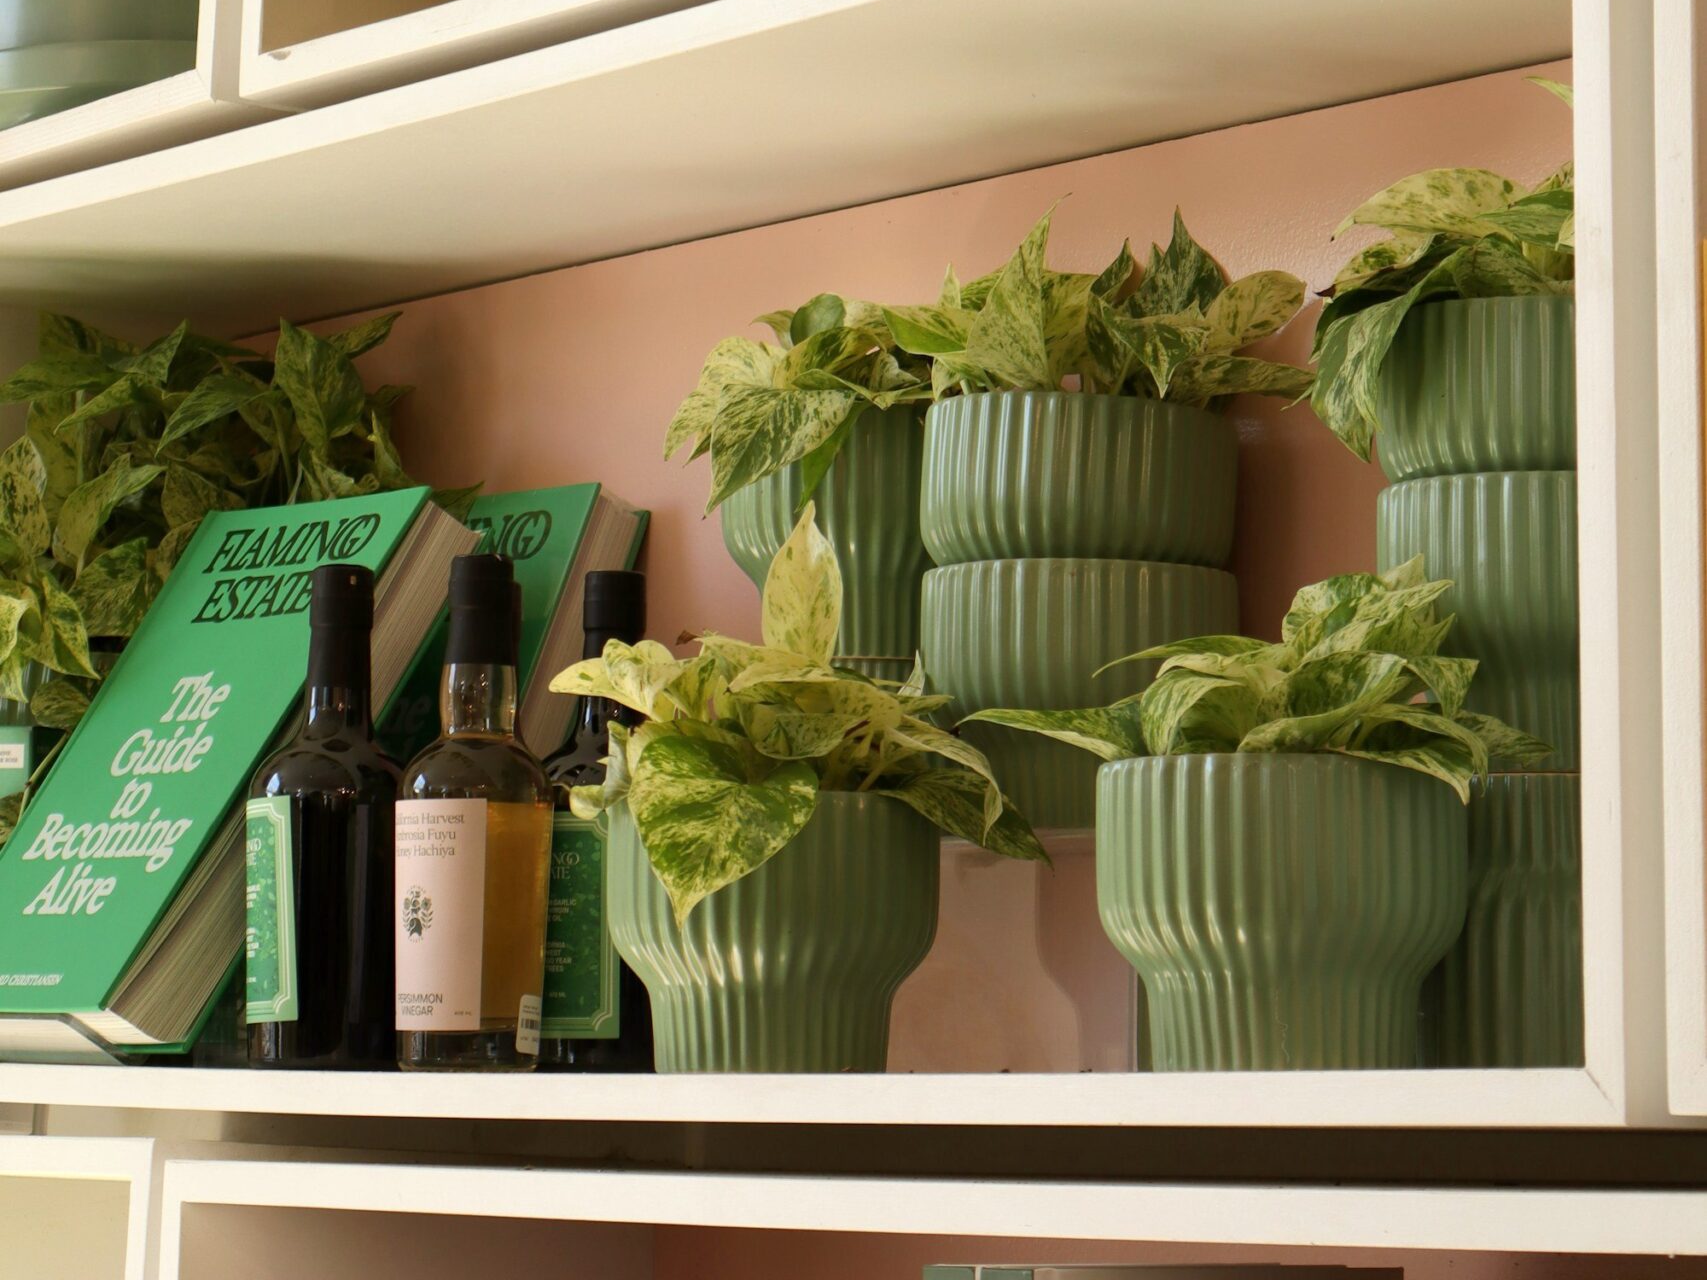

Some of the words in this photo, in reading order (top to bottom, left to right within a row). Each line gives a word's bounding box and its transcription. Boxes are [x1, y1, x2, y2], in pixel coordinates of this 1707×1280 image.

[201, 512, 382, 575] FLAMINGO
[159, 670, 232, 723] The
[110, 721, 214, 777] Guide
[110, 777, 153, 820] to
[421, 812, 465, 824] Harvest
[21, 807, 193, 873] Becoming
[413, 843, 456, 858] Hachiya
[427, 828, 456, 842] Fuyu
[22, 862, 117, 915] Alive
[398, 993, 443, 1004] PERSIMMON
[401, 1005, 433, 1017] VINEGAR
